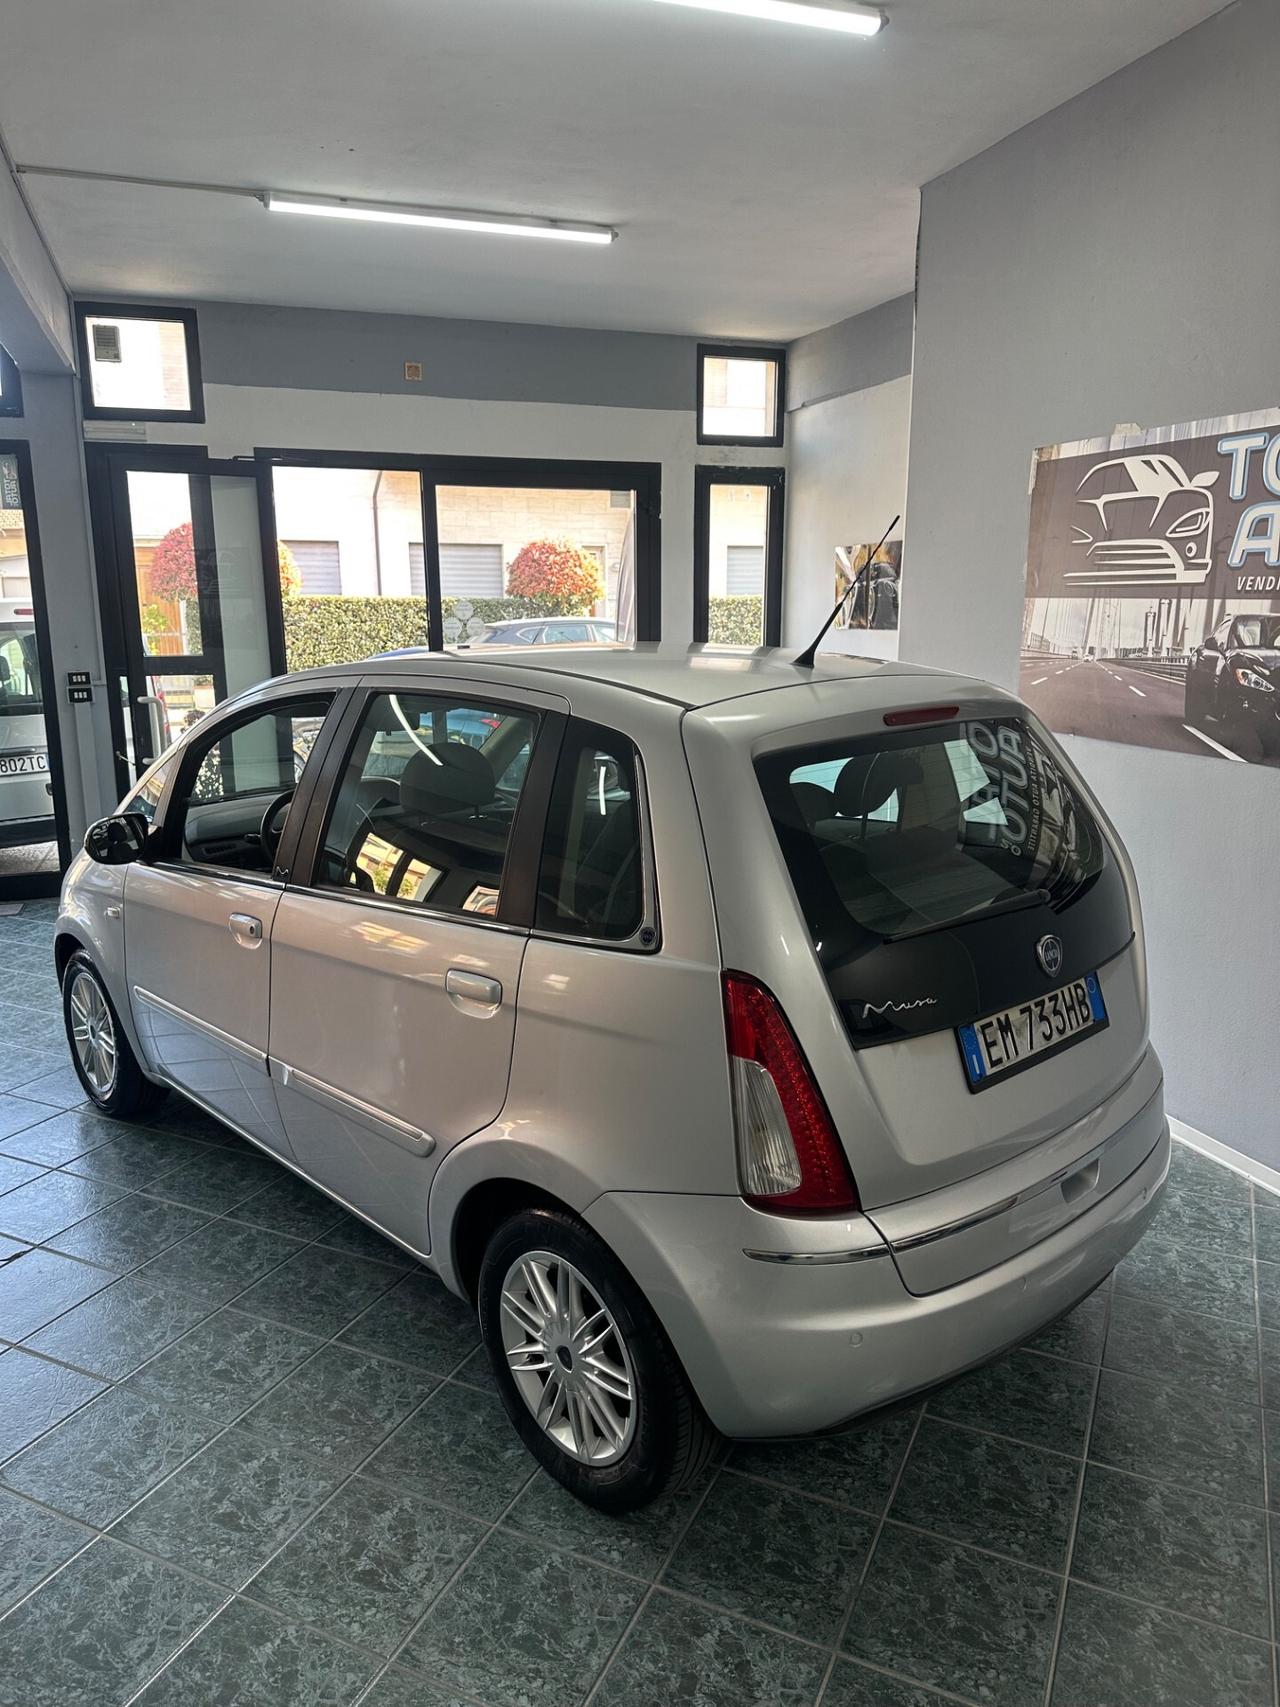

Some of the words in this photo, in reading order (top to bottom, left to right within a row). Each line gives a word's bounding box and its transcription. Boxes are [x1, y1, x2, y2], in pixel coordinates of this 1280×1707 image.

[862, 997, 938, 1019] Musa
[980, 1013, 1019, 1069] EM
[1020, 982, 1091, 1052] 733HB
